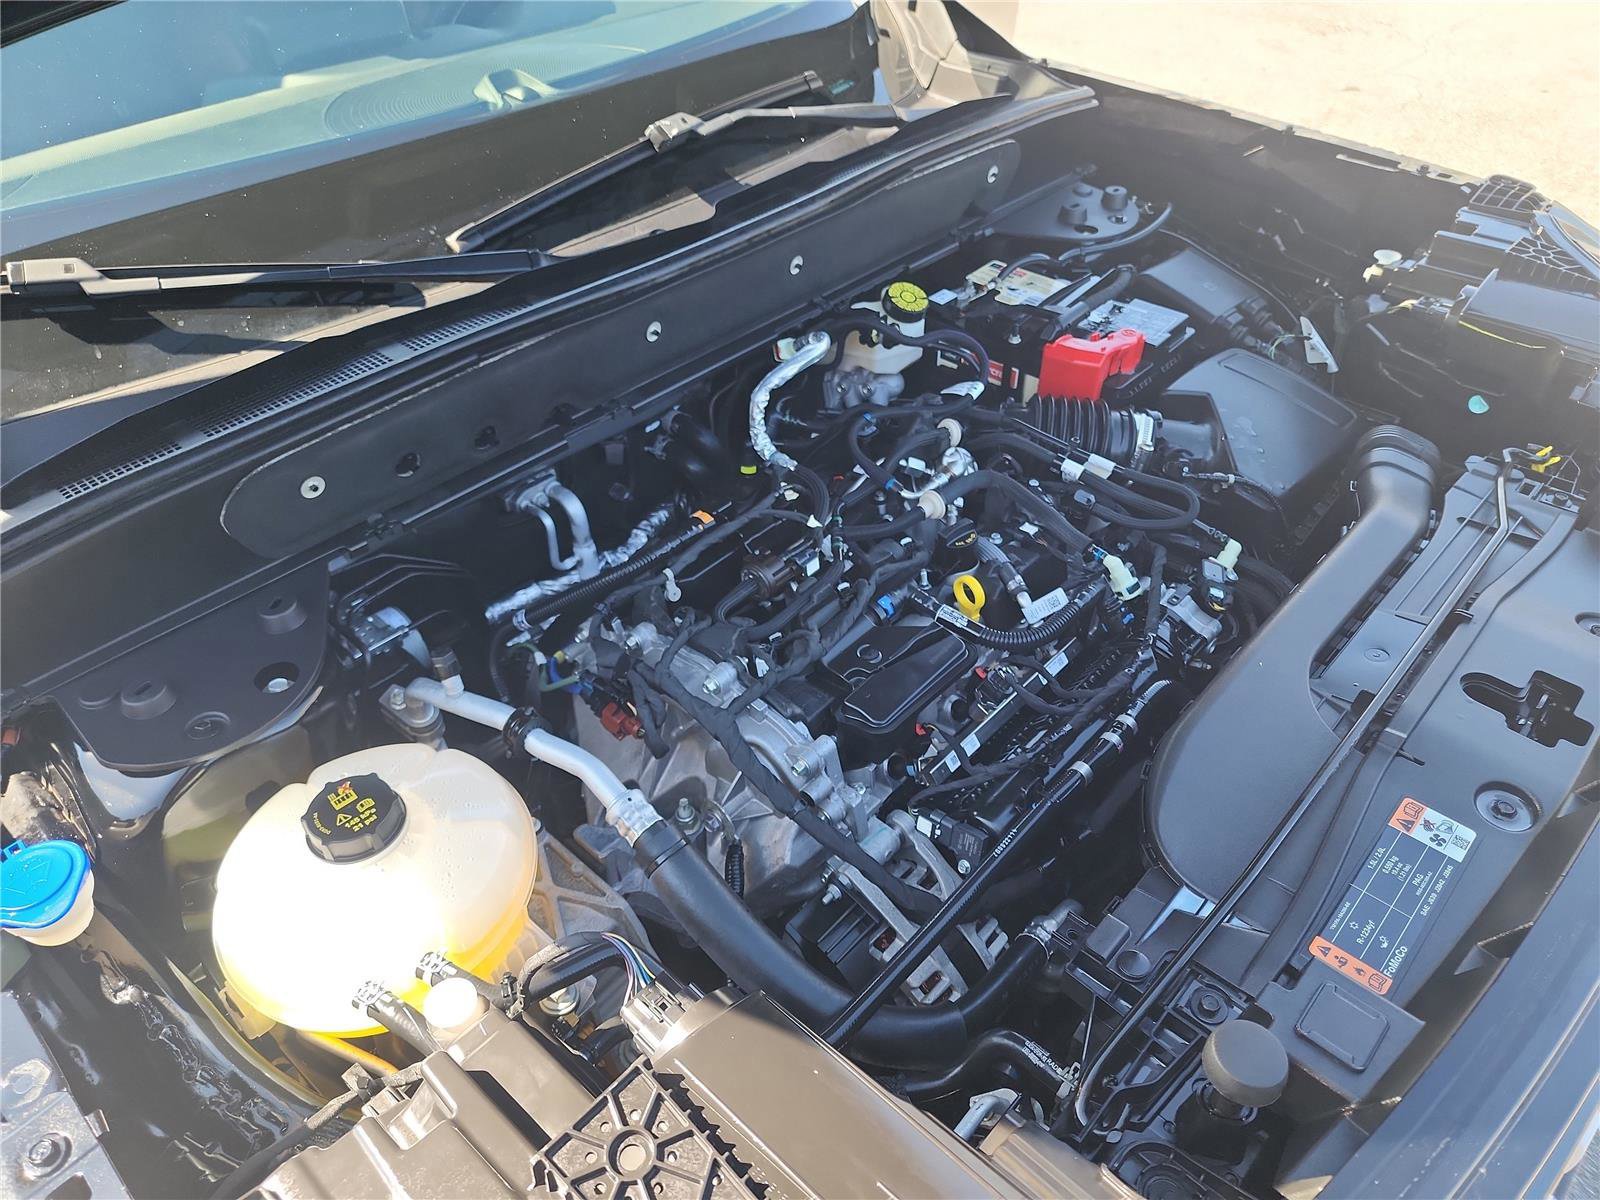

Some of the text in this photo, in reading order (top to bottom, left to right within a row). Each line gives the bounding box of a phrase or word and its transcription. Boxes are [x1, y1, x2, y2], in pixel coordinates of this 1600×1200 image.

[1412, 873, 1424, 886] PAG
[1420, 904, 1431, 916] SAE
[1356, 919, 1377, 946] R-1234yf
[1383, 945, 1408, 977] FoMoCo
